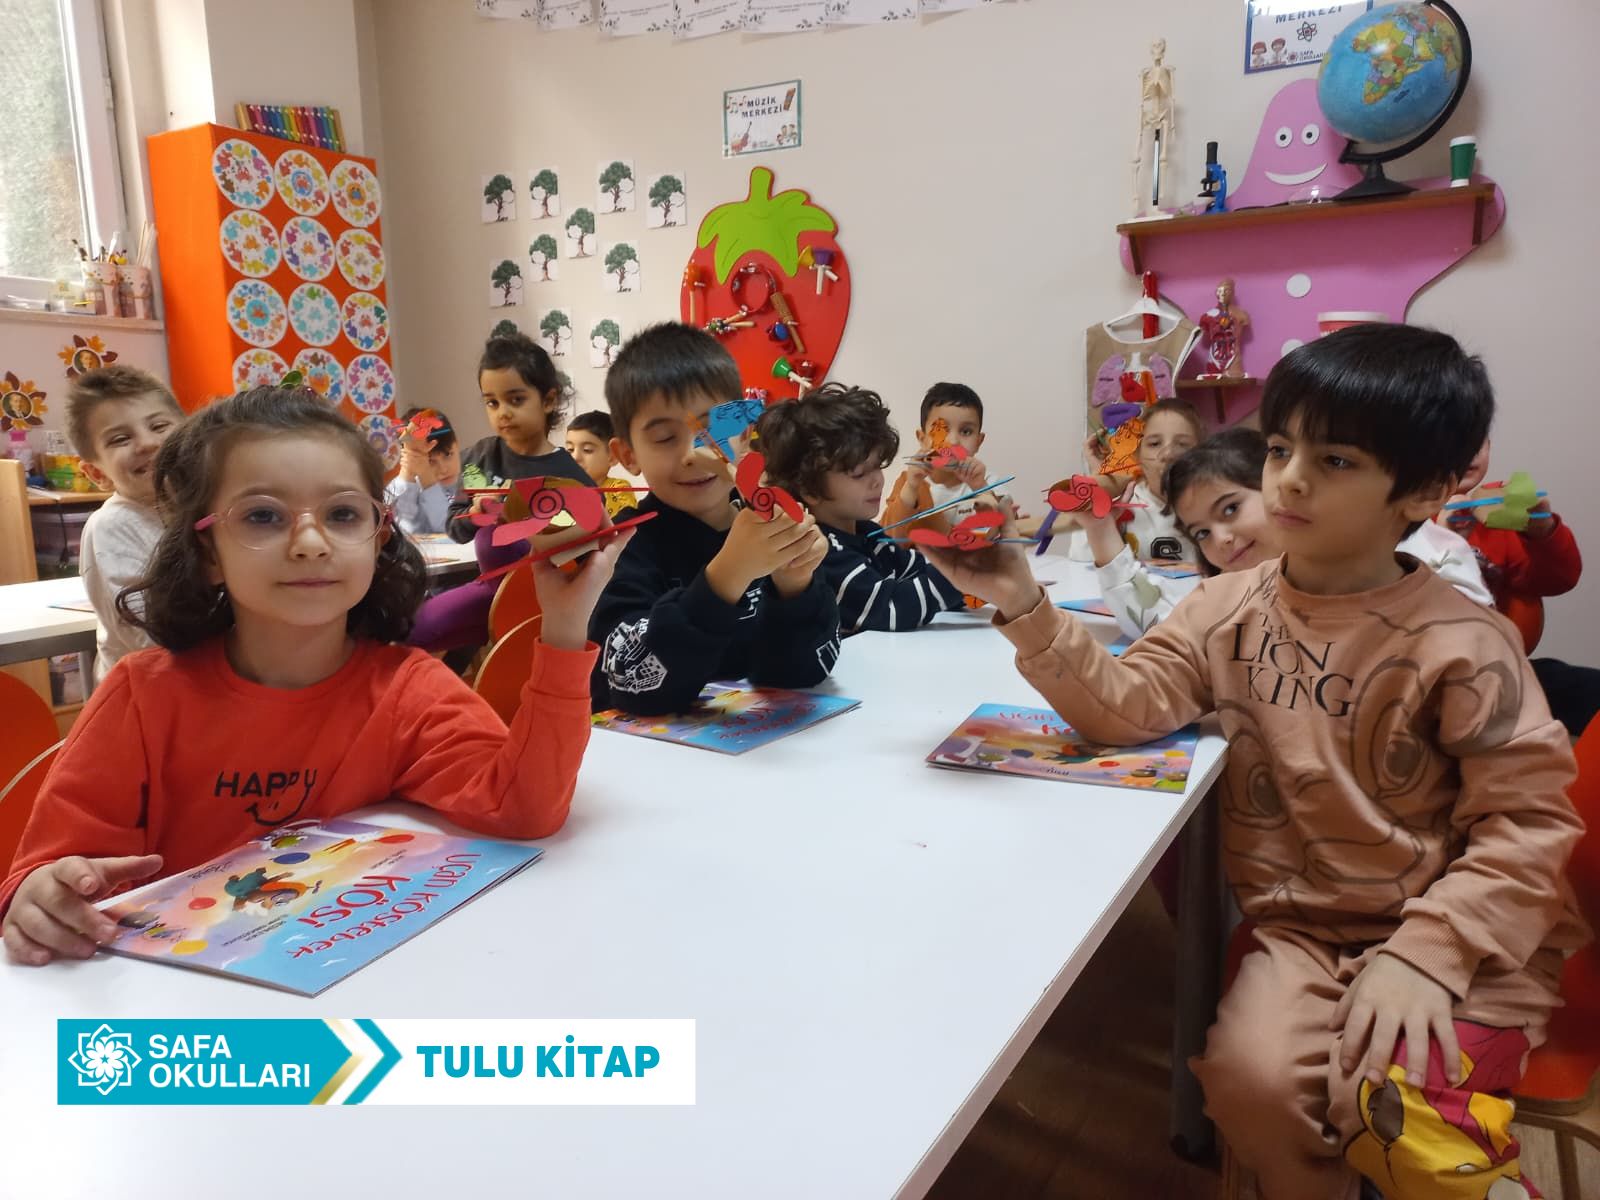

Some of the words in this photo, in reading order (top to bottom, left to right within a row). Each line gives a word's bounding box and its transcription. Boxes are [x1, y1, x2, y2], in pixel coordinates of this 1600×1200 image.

[741, 104, 782, 118] MERKEZİ
[747, 95, 776, 107] MÜZİK
[1229, 622, 1336, 675] LION
[1245, 665, 1355, 717] KING
[214, 768, 318, 814] HAPPY
